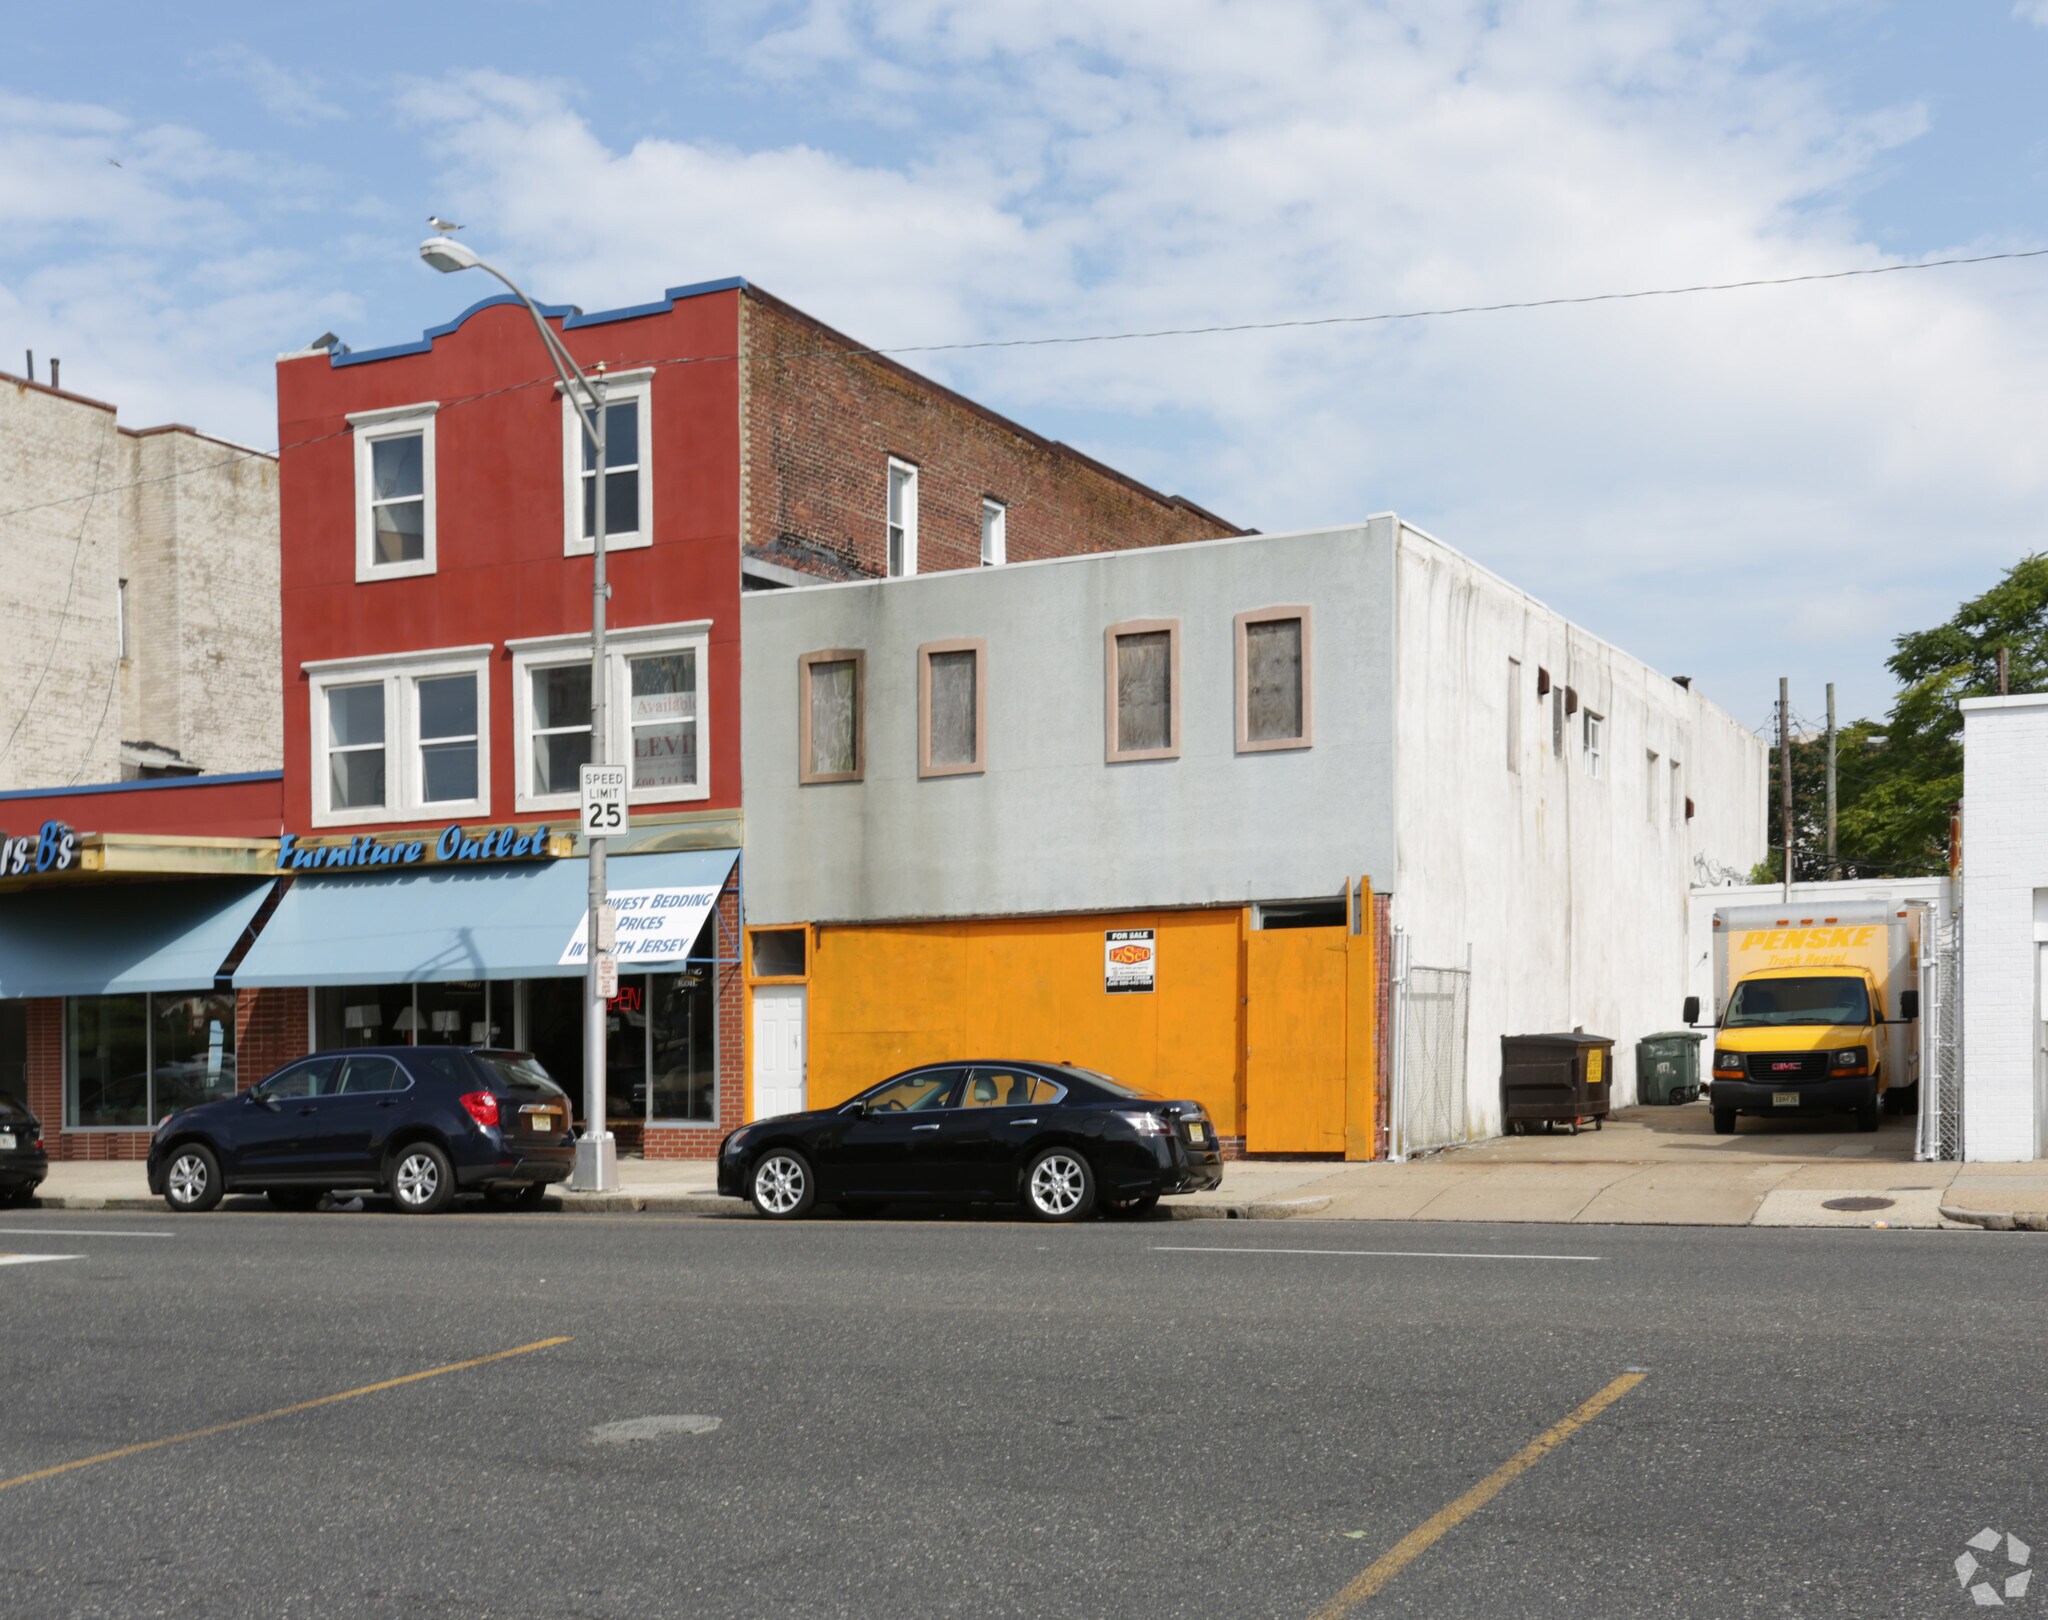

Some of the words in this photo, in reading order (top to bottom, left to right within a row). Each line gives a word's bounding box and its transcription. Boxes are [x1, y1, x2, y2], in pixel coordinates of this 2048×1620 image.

[585, 773, 623, 784] SPEED
[589, 788, 618, 799] LIMIT
[589, 803, 621, 828] 25
[36, 820, 75, 872] B's
[277, 833, 424, 869] Furniture
[436, 824, 550, 861] Outlet
[650, 893, 714, 909] BEDDING
[616, 916, 666, 931] PRICES
[1112, 932, 1128, 940] FOR
[1129, 931, 1148, 939] SALE
[1739, 926, 1878, 951] PENSKE
[568, 941, 587, 956] IN
[636, 938, 690, 954] JERSEY
[1768, 954, 1802, 966] Truck
[1805, 952, 1848, 966] Rental
[606, 986, 642, 1010] PEN
[1771, 1062, 1802, 1071] GMC
